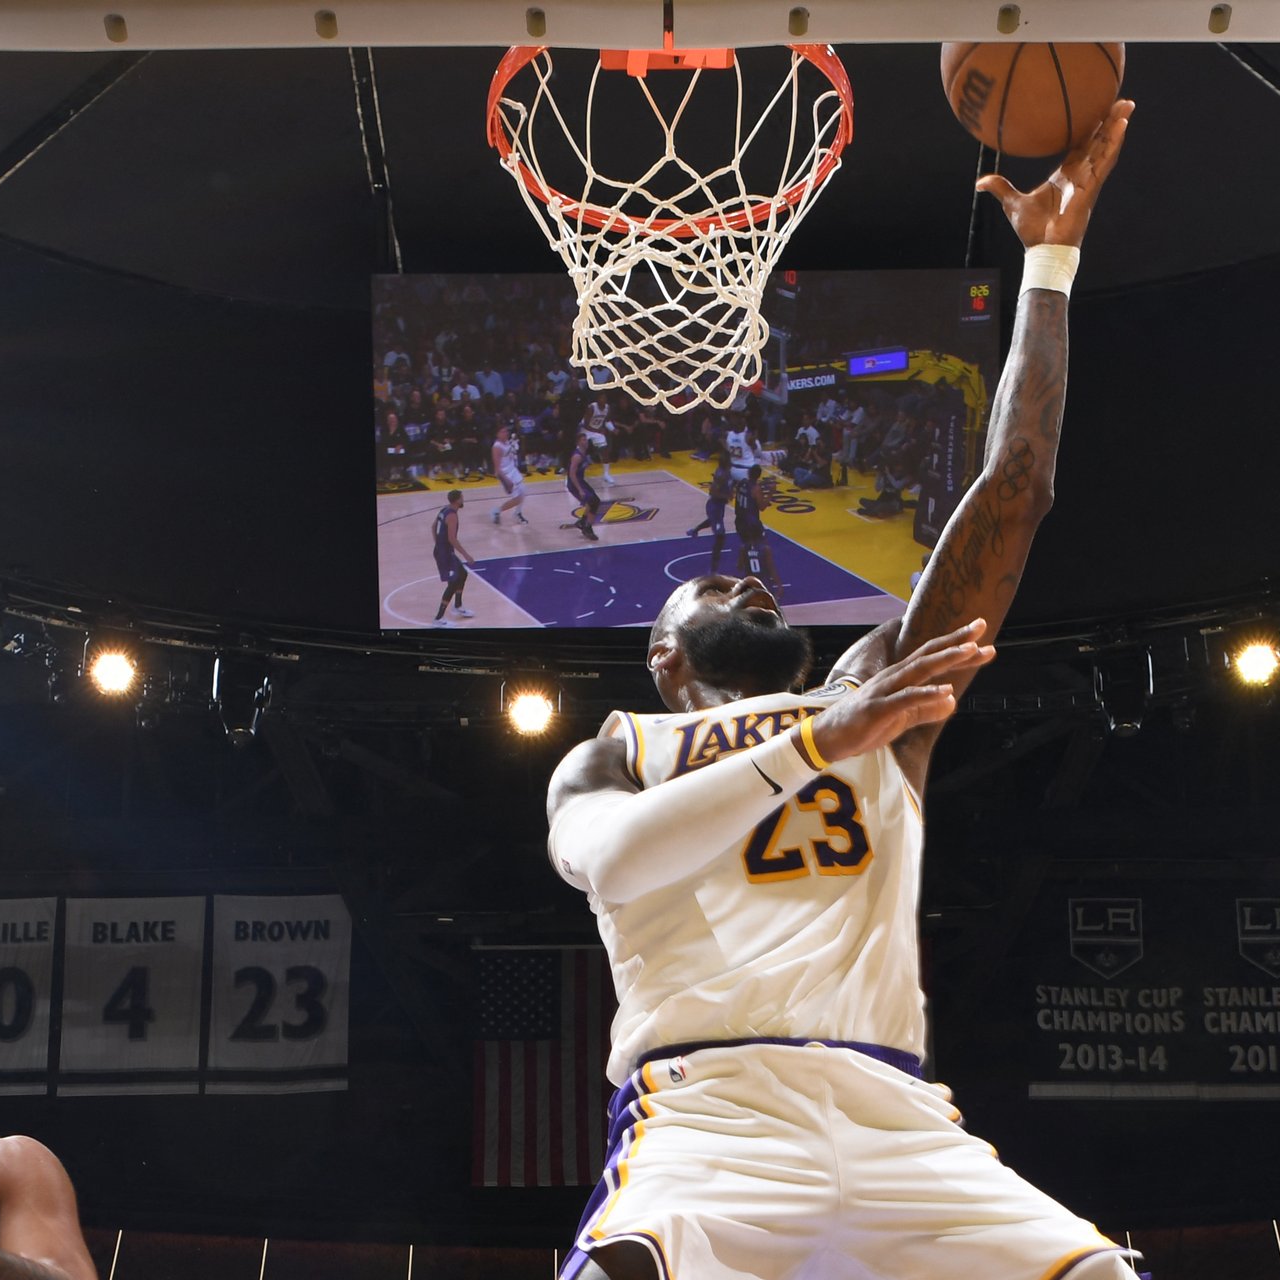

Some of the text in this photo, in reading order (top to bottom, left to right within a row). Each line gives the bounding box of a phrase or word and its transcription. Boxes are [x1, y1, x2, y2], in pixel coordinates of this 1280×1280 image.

[787, 374, 835, 391] AKERS.COM
[670, 706, 826, 780] LAKE
[740, 771, 874, 884] 23
[234, 919, 331, 943] BROWN
[1075, 907, 1137, 932] LA
[92, 921, 176, 944] BLAKE
[102, 966, 155, 1042] 4
[229, 966, 329, 1043] 23
[1036, 986, 1184, 1008] STANLEY CUP
[1037, 1009, 1186, 1034] CHAMPIONS
[1058, 1043, 1168, 1072] 2013-14
